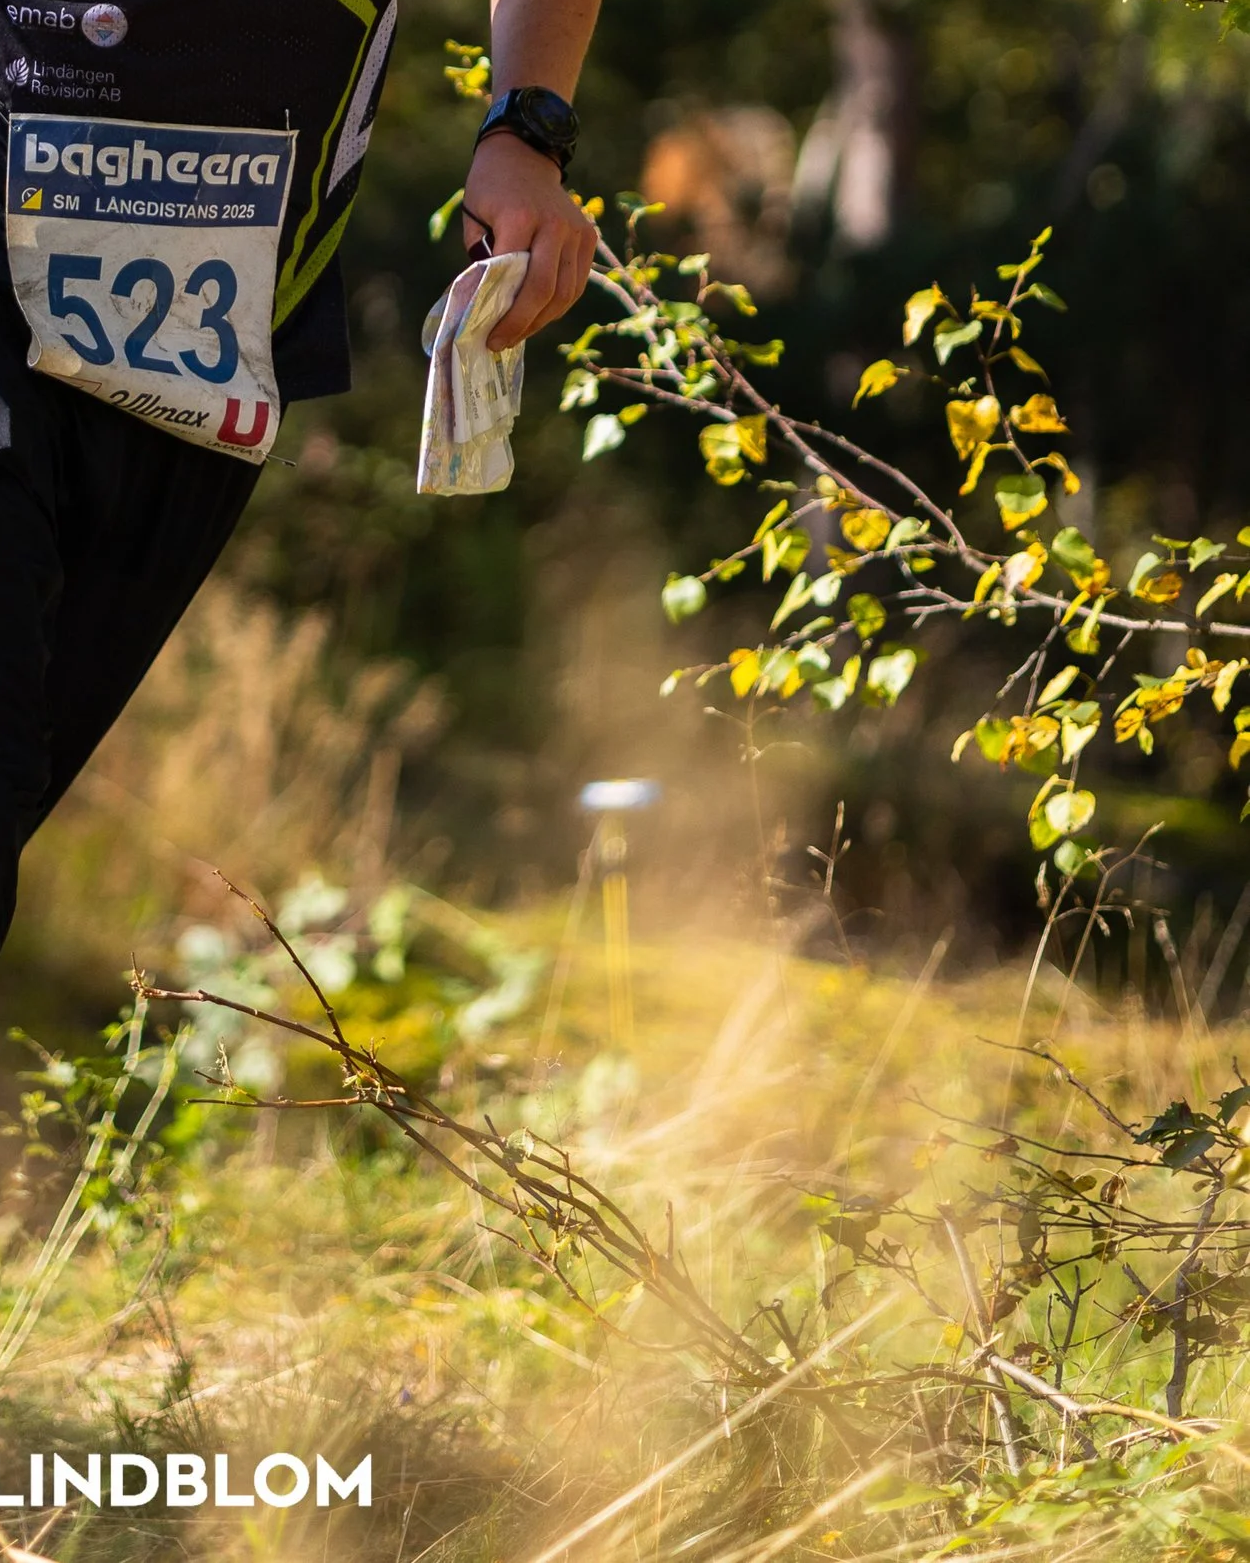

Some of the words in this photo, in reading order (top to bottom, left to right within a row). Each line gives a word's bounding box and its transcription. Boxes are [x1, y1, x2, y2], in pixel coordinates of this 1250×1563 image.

[6, 4, 76, 30] emab
[33, 60, 115, 84] Lindängen
[31, 79, 95, 98] Revision
[98, 87, 121, 102] AB
[24, 133, 281, 187] bagheera
[52, 194, 80, 211] SM
[95, 194, 218, 220] LÅNGDISTANS
[221, 203, 256, 219] 2025
[47, 253, 240, 385] 523
